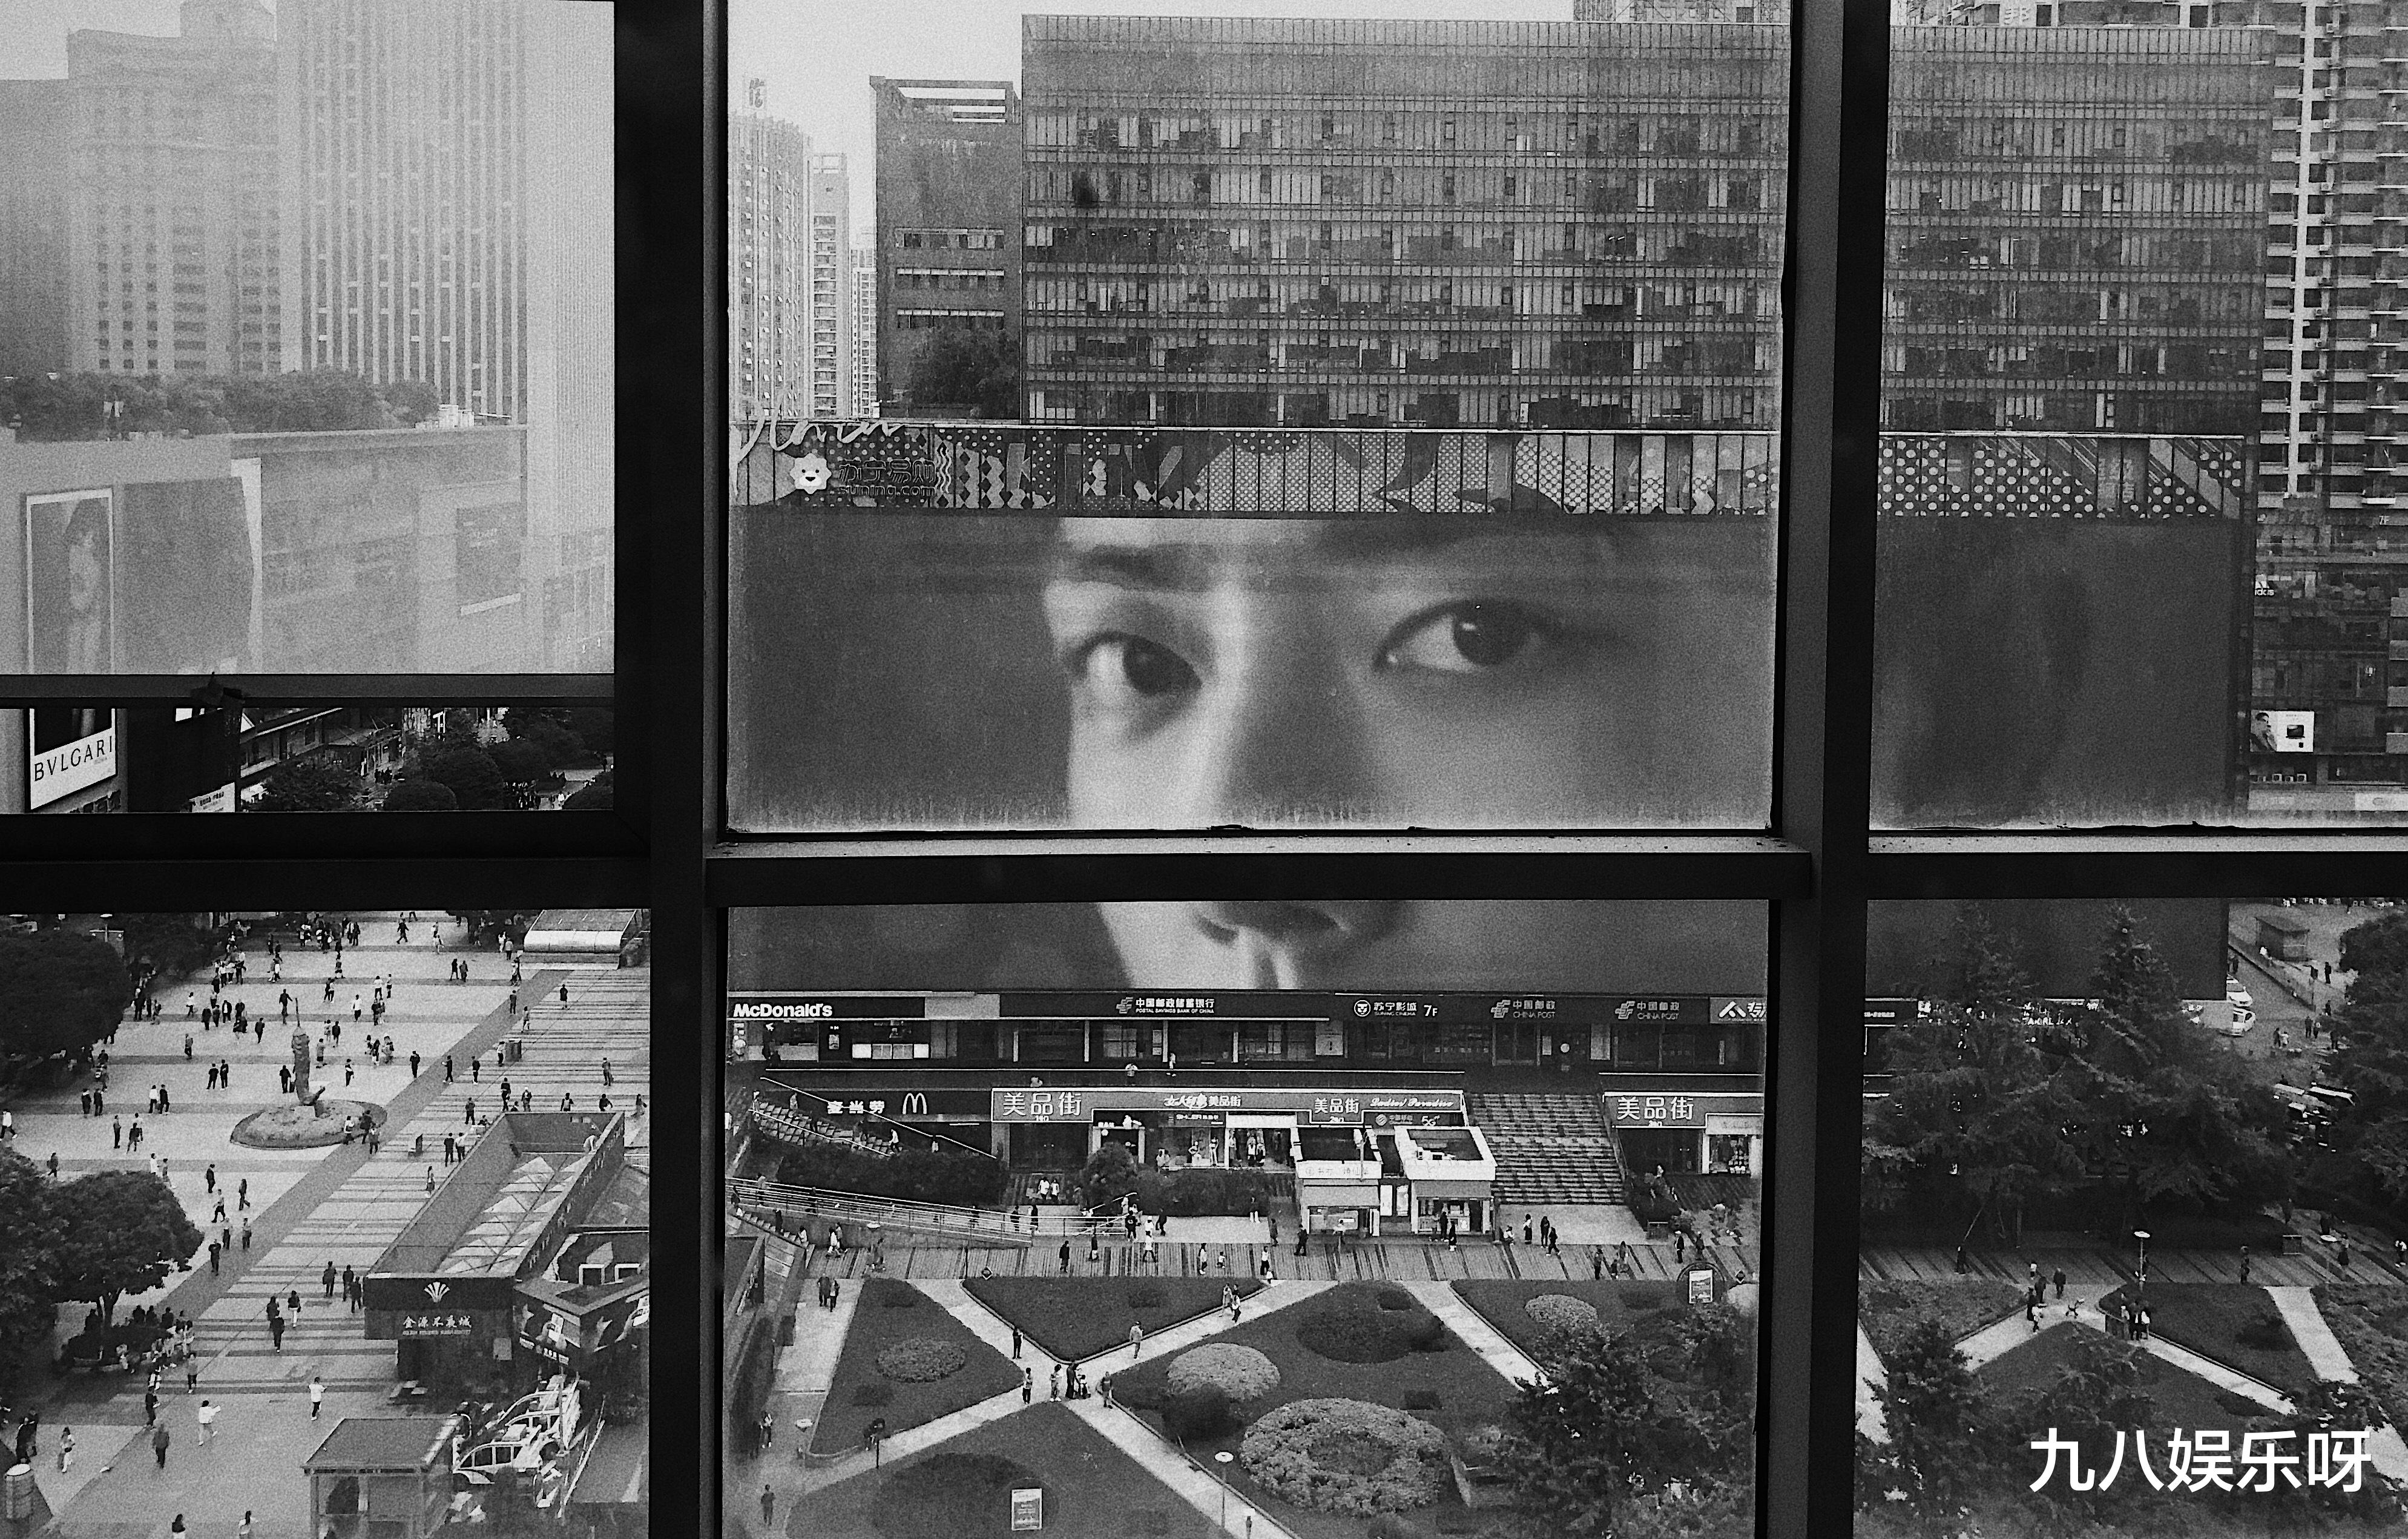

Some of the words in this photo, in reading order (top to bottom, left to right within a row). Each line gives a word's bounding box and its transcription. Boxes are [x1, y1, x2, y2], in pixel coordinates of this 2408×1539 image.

[839, 457, 936, 483] 苏宁易购
[839, 485, 936, 501] suning.com
[35, 736, 112, 782] BVLGARI
[733, 1003, 832, 1017] McDonald's
[1136, 998, 1214, 1008] 中国邮政储蓄银行
[1373, 1002, 1416, 1011] 苏宁影城
[1424, 1004, 1438, 1017] 7F
[1513, 1000, 1555, 1009] 中国邮政
[1637, 1000, 1679, 1010] 中国邮政
[827, 1100, 885, 1114] 麦当劳
[1002, 1092, 1082, 1116] 美品街
[1314, 1097, 1360, 1114] 美品街
[1617, 1096, 1694, 1120] 美品街
